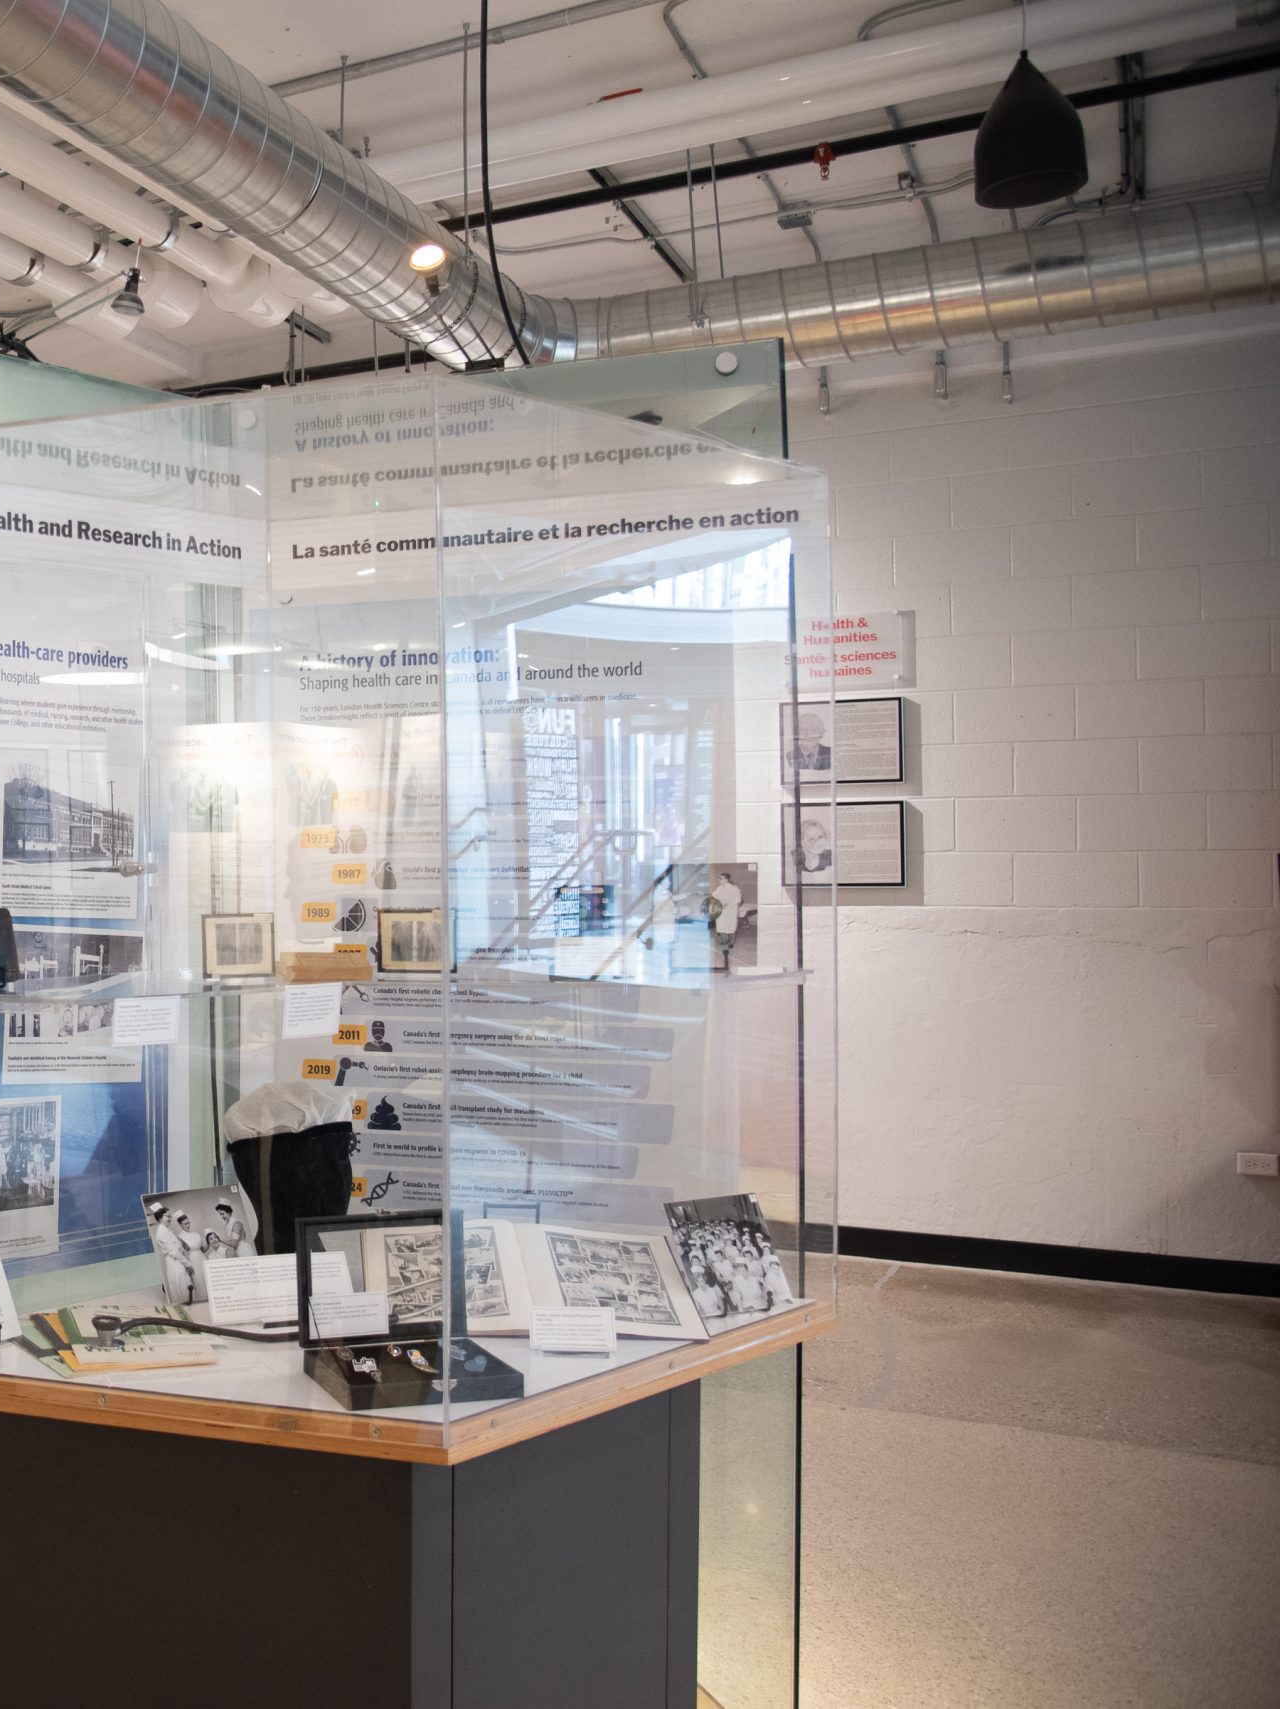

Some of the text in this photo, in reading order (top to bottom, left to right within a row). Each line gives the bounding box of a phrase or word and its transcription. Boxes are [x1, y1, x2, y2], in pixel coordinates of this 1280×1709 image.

[38, 519, 72, 537] and
[77, 521, 162, 548] Research
[166, 532, 181, 551] in
[186, 536, 241, 558] Action
[292, 544, 314, 559] La
[319, 539, 371, 556] santé
[538, 524, 559, 540] et
[564, 522, 581, 538] la
[586, 515, 693, 536] recherche
[698, 514, 724, 528] en
[730, 507, 798, 525] action
[857, 617, 868, 628] &
[68, 650, 129, 669] providers
[379, 650, 396, 674] of
[840, 650, 897, 662] sciences
[0, 668, 40, 685] hospitals
[299, 661, 642, 691] Shaping health care in around the world
[338, 868, 360, 879] 1987
[306, 907, 330, 918] 1989
[338, 1030, 360, 1040] 2011
[308, 1064, 330, 1075] 2019
